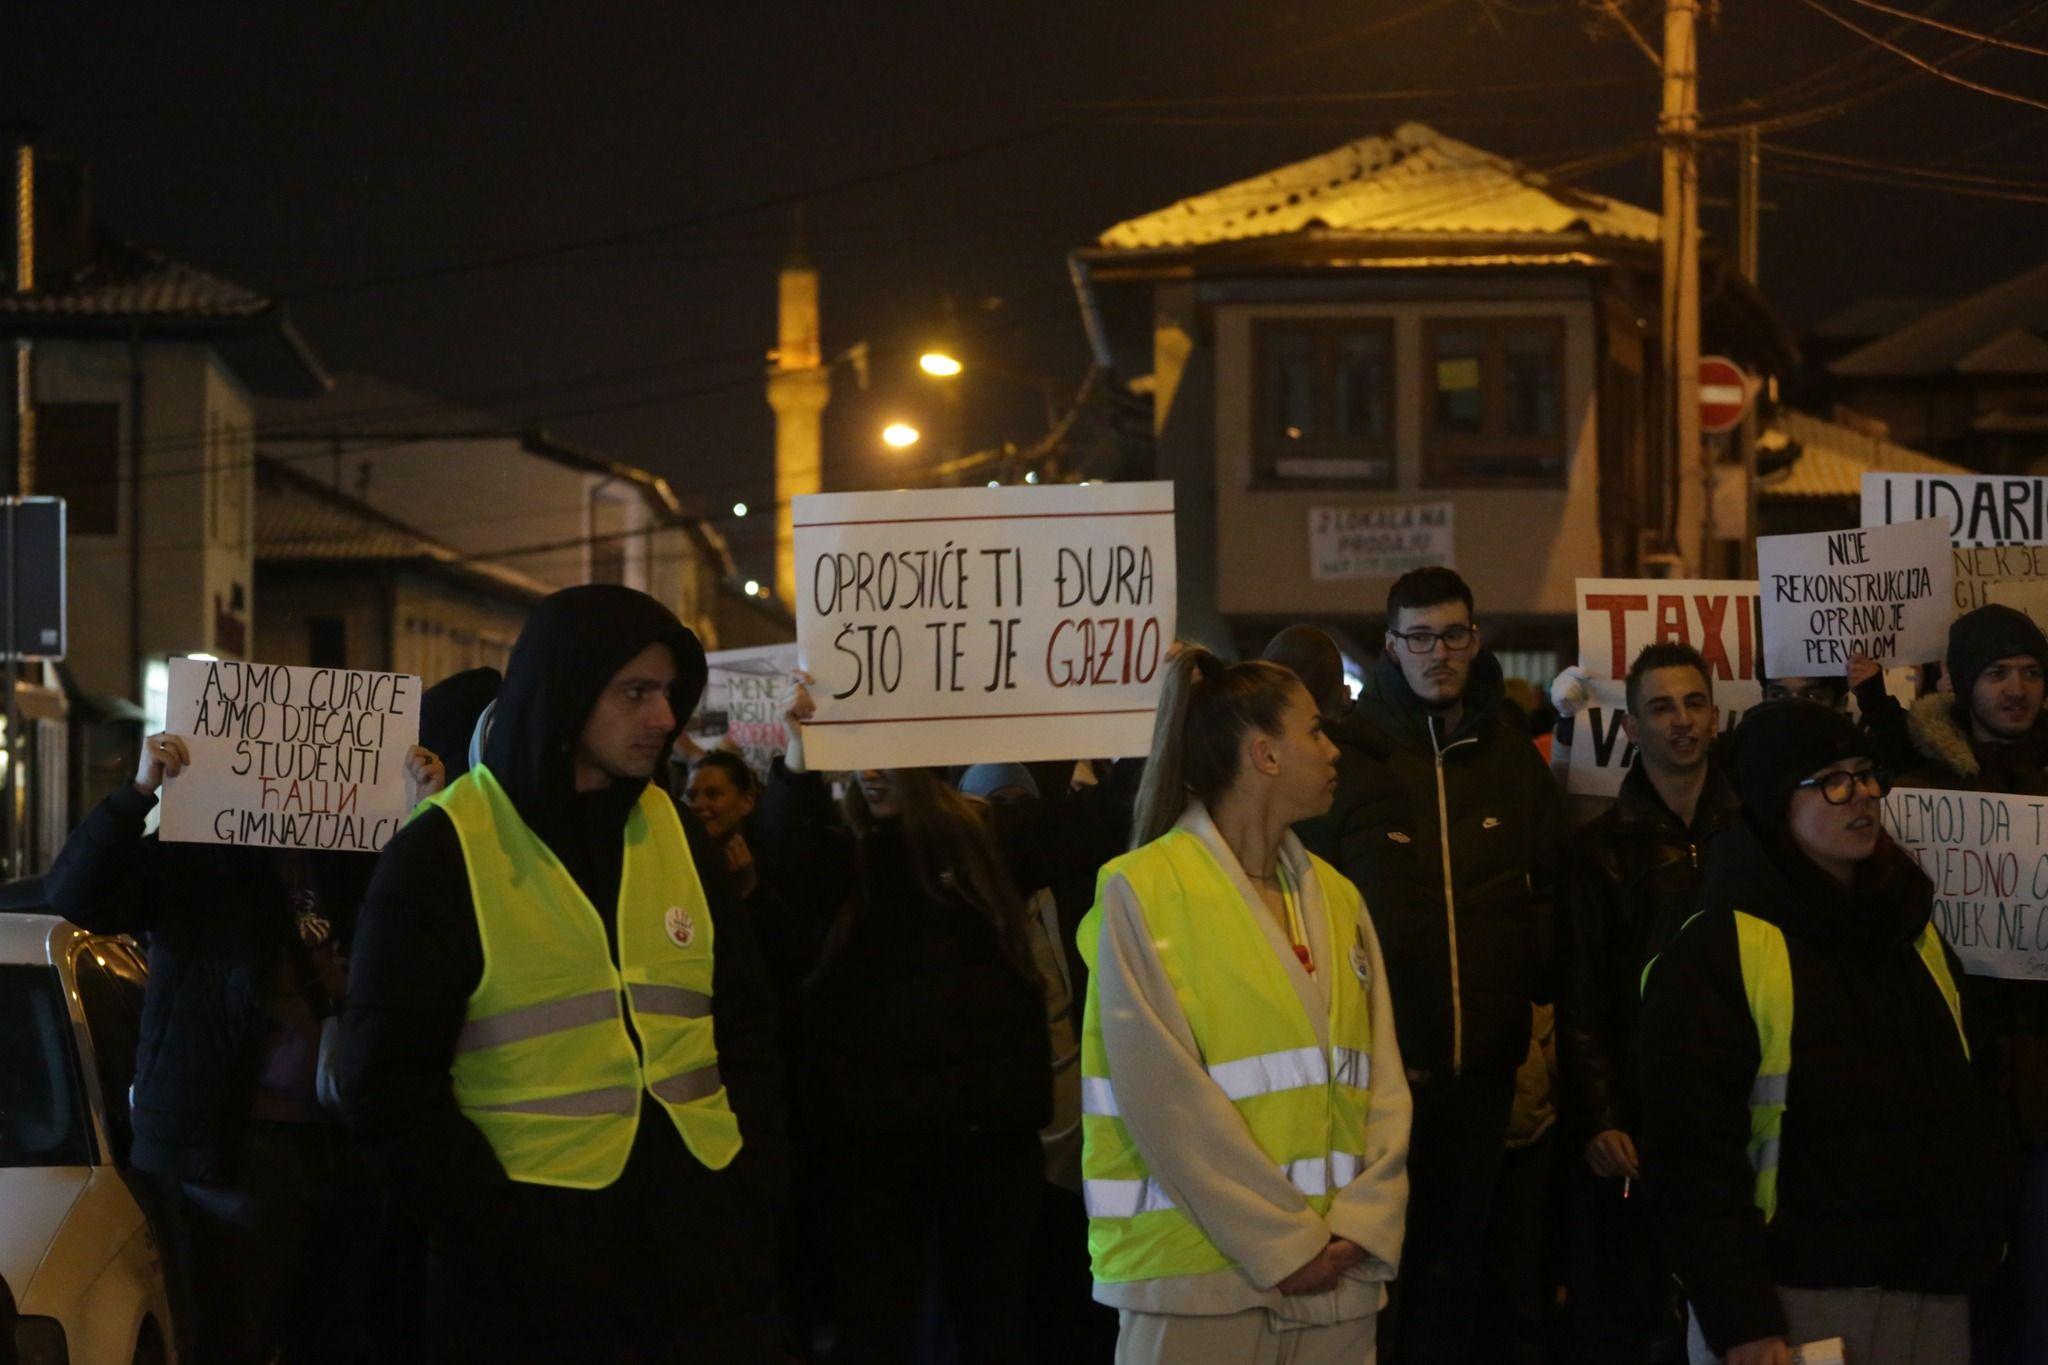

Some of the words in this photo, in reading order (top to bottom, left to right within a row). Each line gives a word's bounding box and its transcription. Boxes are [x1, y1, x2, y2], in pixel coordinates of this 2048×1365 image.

[1828, 531, 1870, 566] NIJE
[814, 540, 968, 616] OPROSTIĆE
[980, 546, 1023, 608] TI
[1054, 544, 1153, 608] ĐURA
[1771, 566, 1932, 604] REKONSTRUKCIJA
[1585, 594, 1752, 680] TAXI
[1810, 603, 1885, 636] OPRANO
[1887, 604, 1905, 633] JE
[832, 622, 902, 700] ŠTO
[925, 622, 966, 693] TE
[984, 618, 1021, 693] JE
[1046, 616, 1160, 689] GAZIO
[1801, 633, 1896, 665] PERVOLOM
[308, 669, 410, 715] CURICE
[231, 739, 380, 785] STUDENTI
[1883, 793, 1965, 845] NEMOJ
[1979, 797, 2010, 846] DA
[1996, 901, 2031, 951] NE
